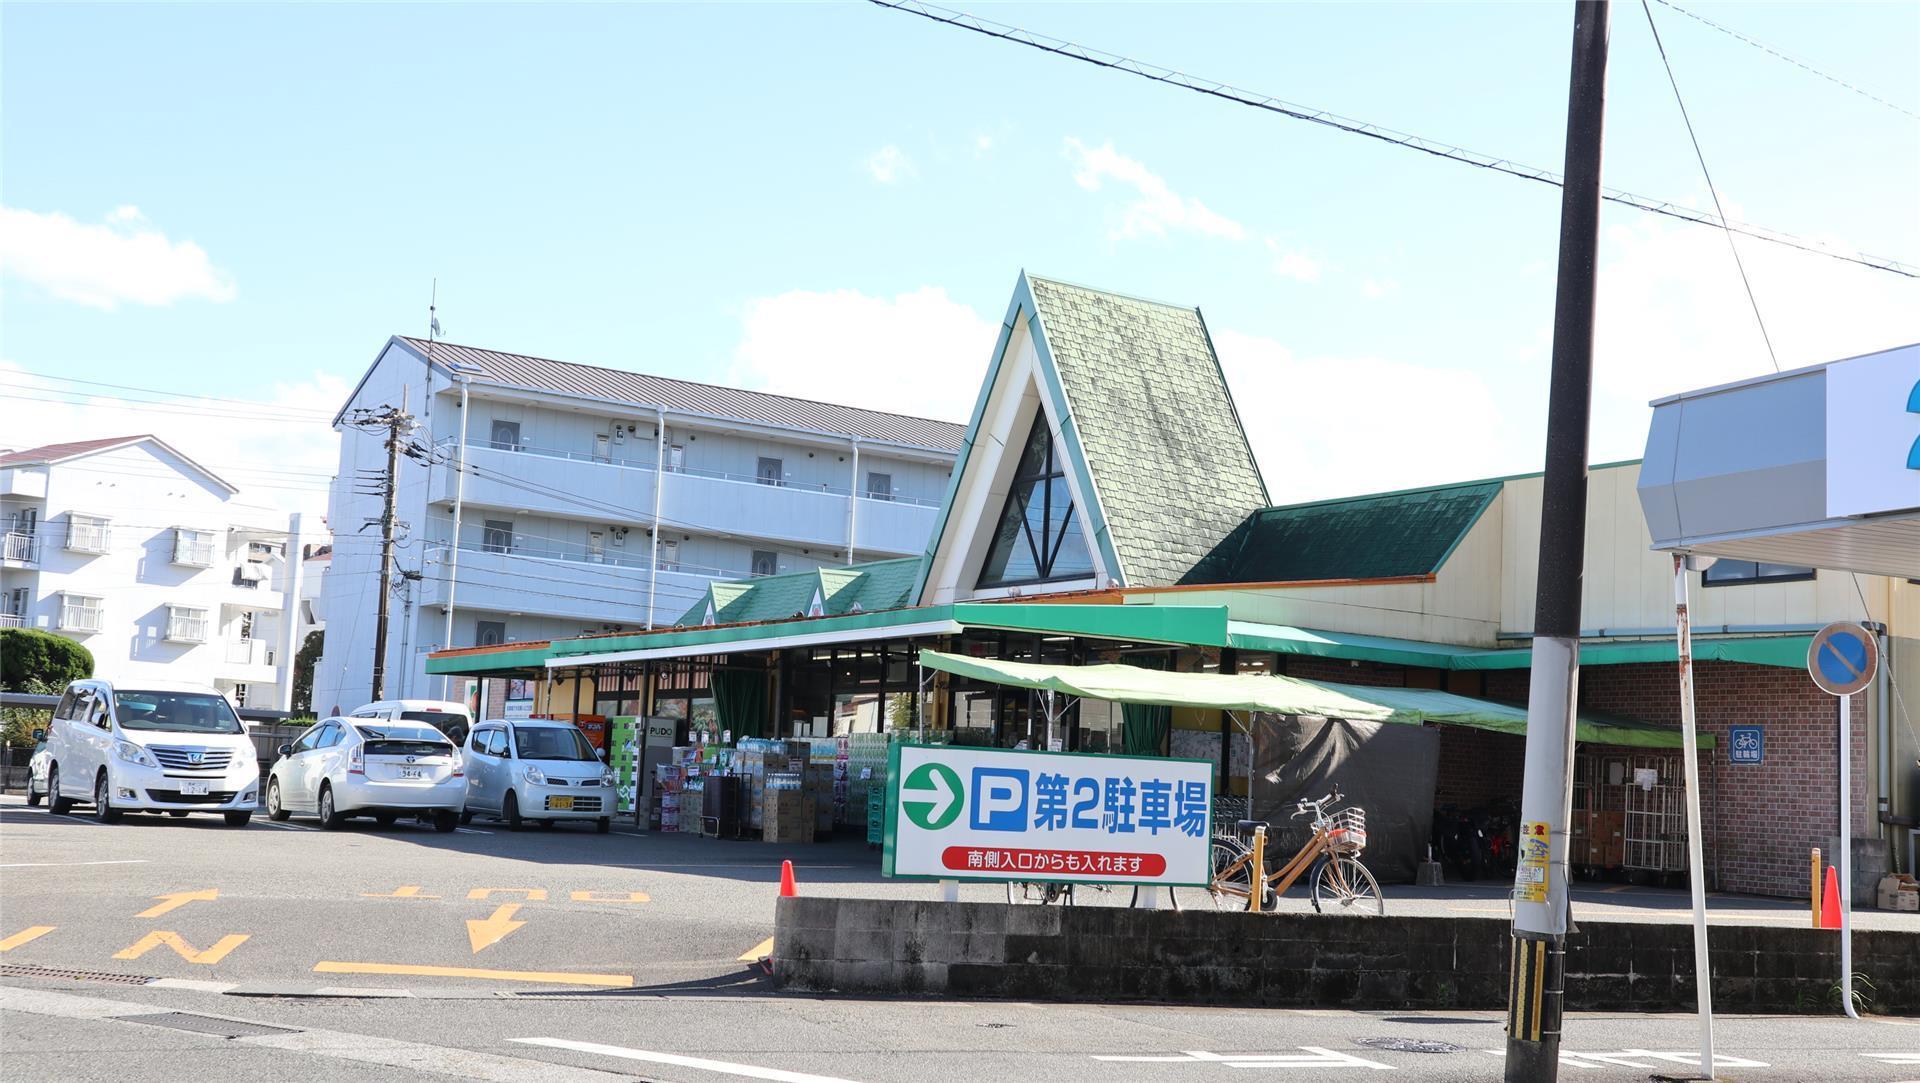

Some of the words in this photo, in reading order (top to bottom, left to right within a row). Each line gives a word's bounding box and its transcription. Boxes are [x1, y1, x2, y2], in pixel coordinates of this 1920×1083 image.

[650, 727, 672, 735] PUDO
[978, 775, 1022, 824] P
[1034, 774, 1207, 837] 第2駐車場
[967, 850, 1143, 873] 南側入口からも入れます
